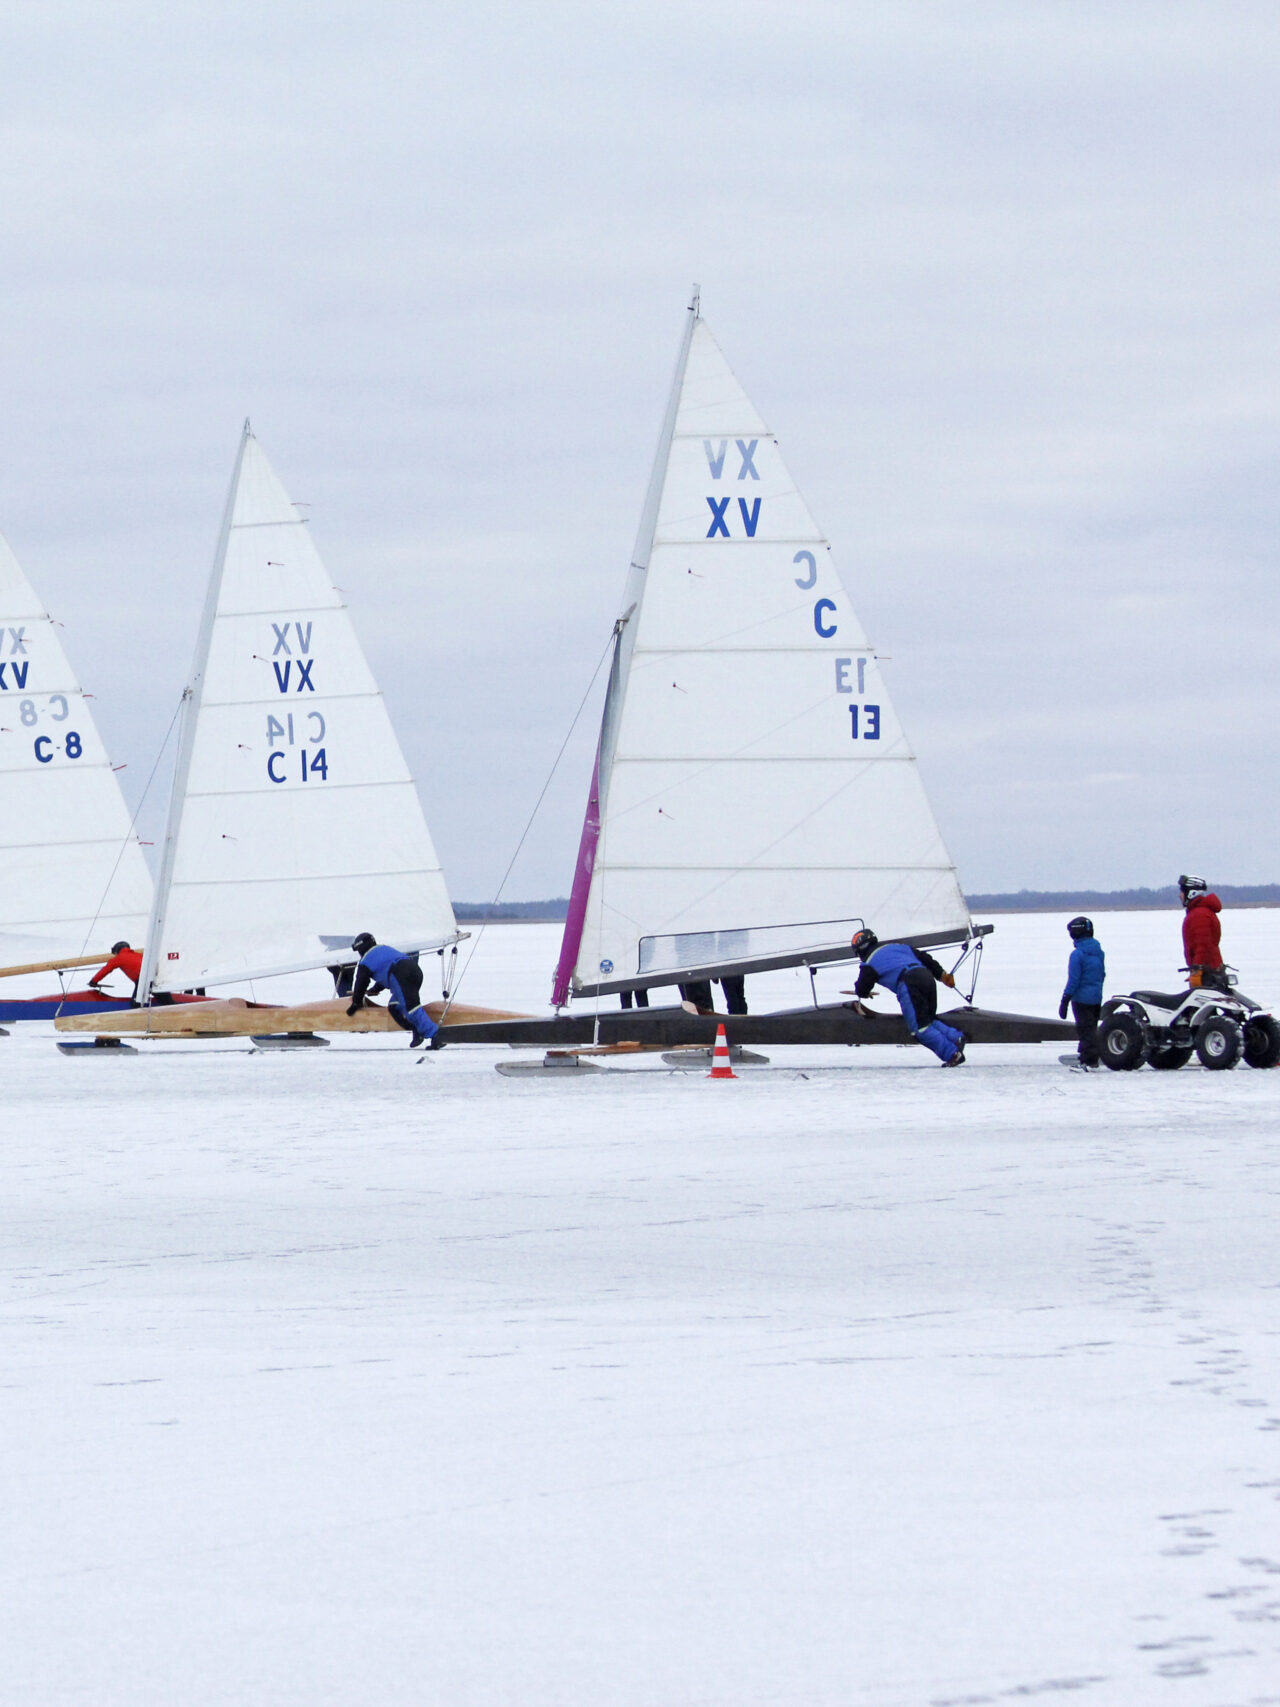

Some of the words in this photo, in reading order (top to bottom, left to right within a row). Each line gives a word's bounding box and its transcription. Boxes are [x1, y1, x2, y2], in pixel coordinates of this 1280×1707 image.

[706, 497, 762, 538] XV
[814, 598, 837, 638] C
[272, 659, 315, 693] VX
[849, 704, 880, 740] 13
[34, 731, 82, 763] C-8
[267, 751, 287, 783] C
[301, 748, 328, 782] 14
